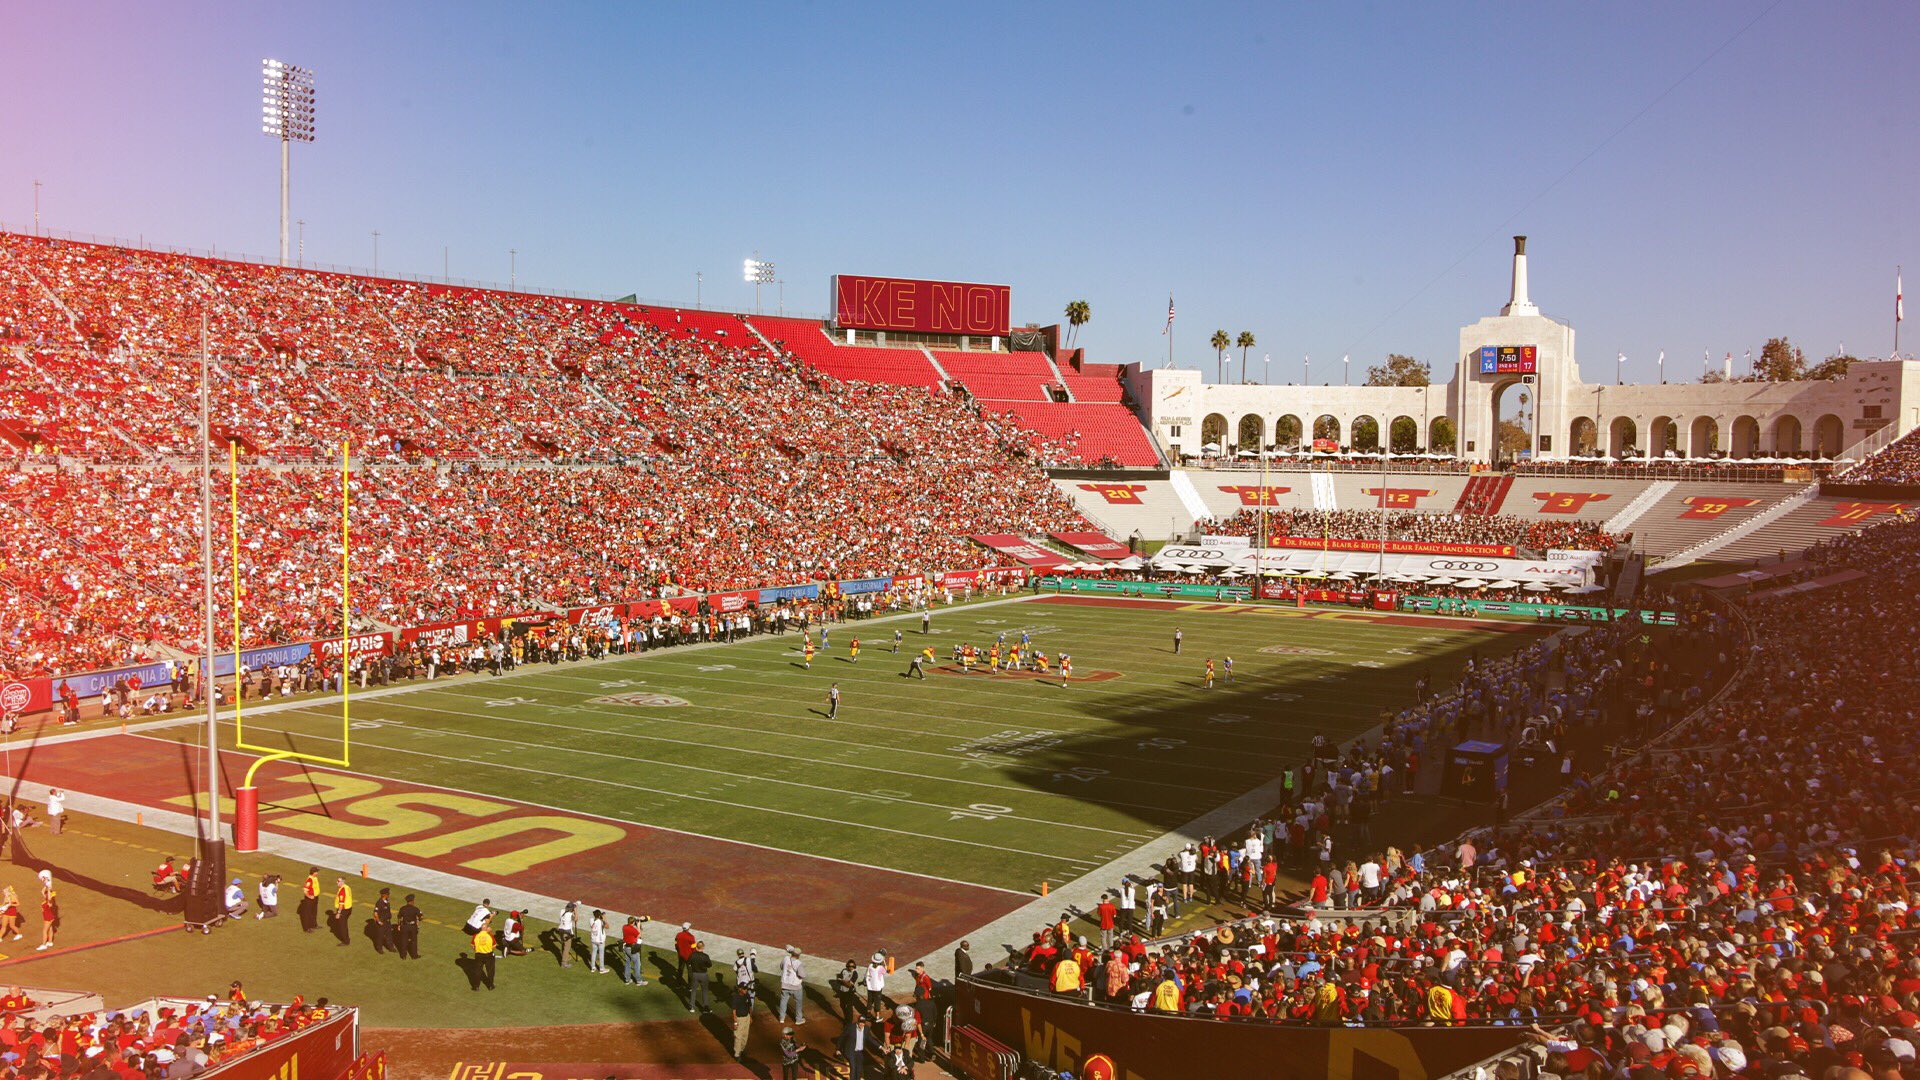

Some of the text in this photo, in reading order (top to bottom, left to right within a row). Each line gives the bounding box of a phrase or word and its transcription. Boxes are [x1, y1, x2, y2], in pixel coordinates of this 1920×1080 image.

[1500, 354, 1517, 362] 7:50
[1106, 489, 1131, 499] 20
[1245, 490, 1270, 500] 32
[1387, 493, 1410, 503] 12
[1558, 498, 1574, 507] 3
[1695, 503, 1728, 514] 33
[1840, 509, 1872, 519] 11
[1332, 541, 1352, 549] BLAIR
[1392, 543, 1413, 551] BLAIR
[1415, 544, 1440, 552] FAMILY
[1442, 545, 1463, 553] BAND
[1465, 546, 1497, 554] SECTION
[1525, 567, 1578, 575] Audi
[1175, 604, 1389, 623] USC
[419, 628, 453, 639] UNITED
[322, 635, 384, 656] ONTARIO
[236, 650, 289, 669] ALIFORNIA
[90, 668, 156, 691] CALIFONIA
[1052, 766, 1111, 782] 20
[948, 803, 1013, 821] 10
[162, 771, 627, 876] USC
[311, 1009, 326, 1020] 25
